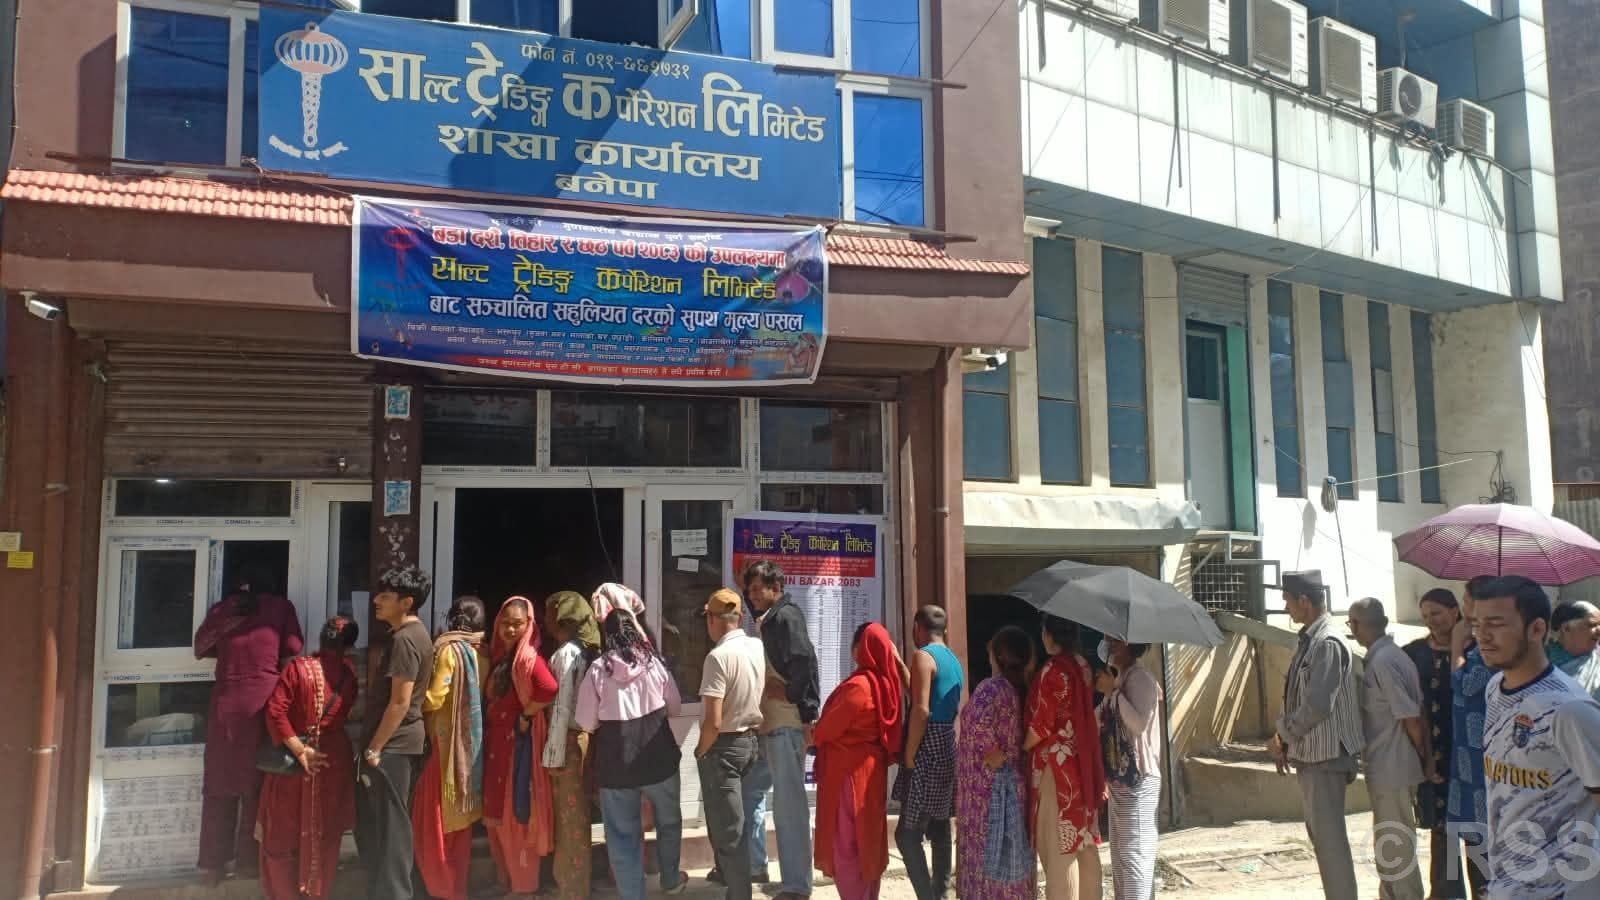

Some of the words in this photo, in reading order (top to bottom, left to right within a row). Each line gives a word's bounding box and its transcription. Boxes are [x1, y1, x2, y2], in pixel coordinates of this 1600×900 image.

[520, 41, 556, 61] फोन
[562, 47, 578, 66] नं.
[359, 47, 462, 103] साल्ट
[702, 71, 826, 142] लिमिटेड
[438, 124, 560, 161] शाखा
[575, 139, 762, 181] कार्यालय
[555, 171, 659, 199] बनेपा
[509, 229, 559, 253] तिहार
[561, 236, 574, 255] र
[432, 256, 489, 283] साल्ट
[702, 268, 778, 300] लिमिटेड
[430, 295, 462, 315] बाट
[466, 293, 549, 320] सञ्चालित
[552, 298, 628, 327] सहुलियत
[631, 303, 675, 327] दरको
[681, 309, 719, 333] सुपथ
[724, 310, 761, 334] मूल्य
[765, 313, 805, 333] पसल
[800, 577, 834, 587] BAZAR
[838, 578, 861, 588] 2083
